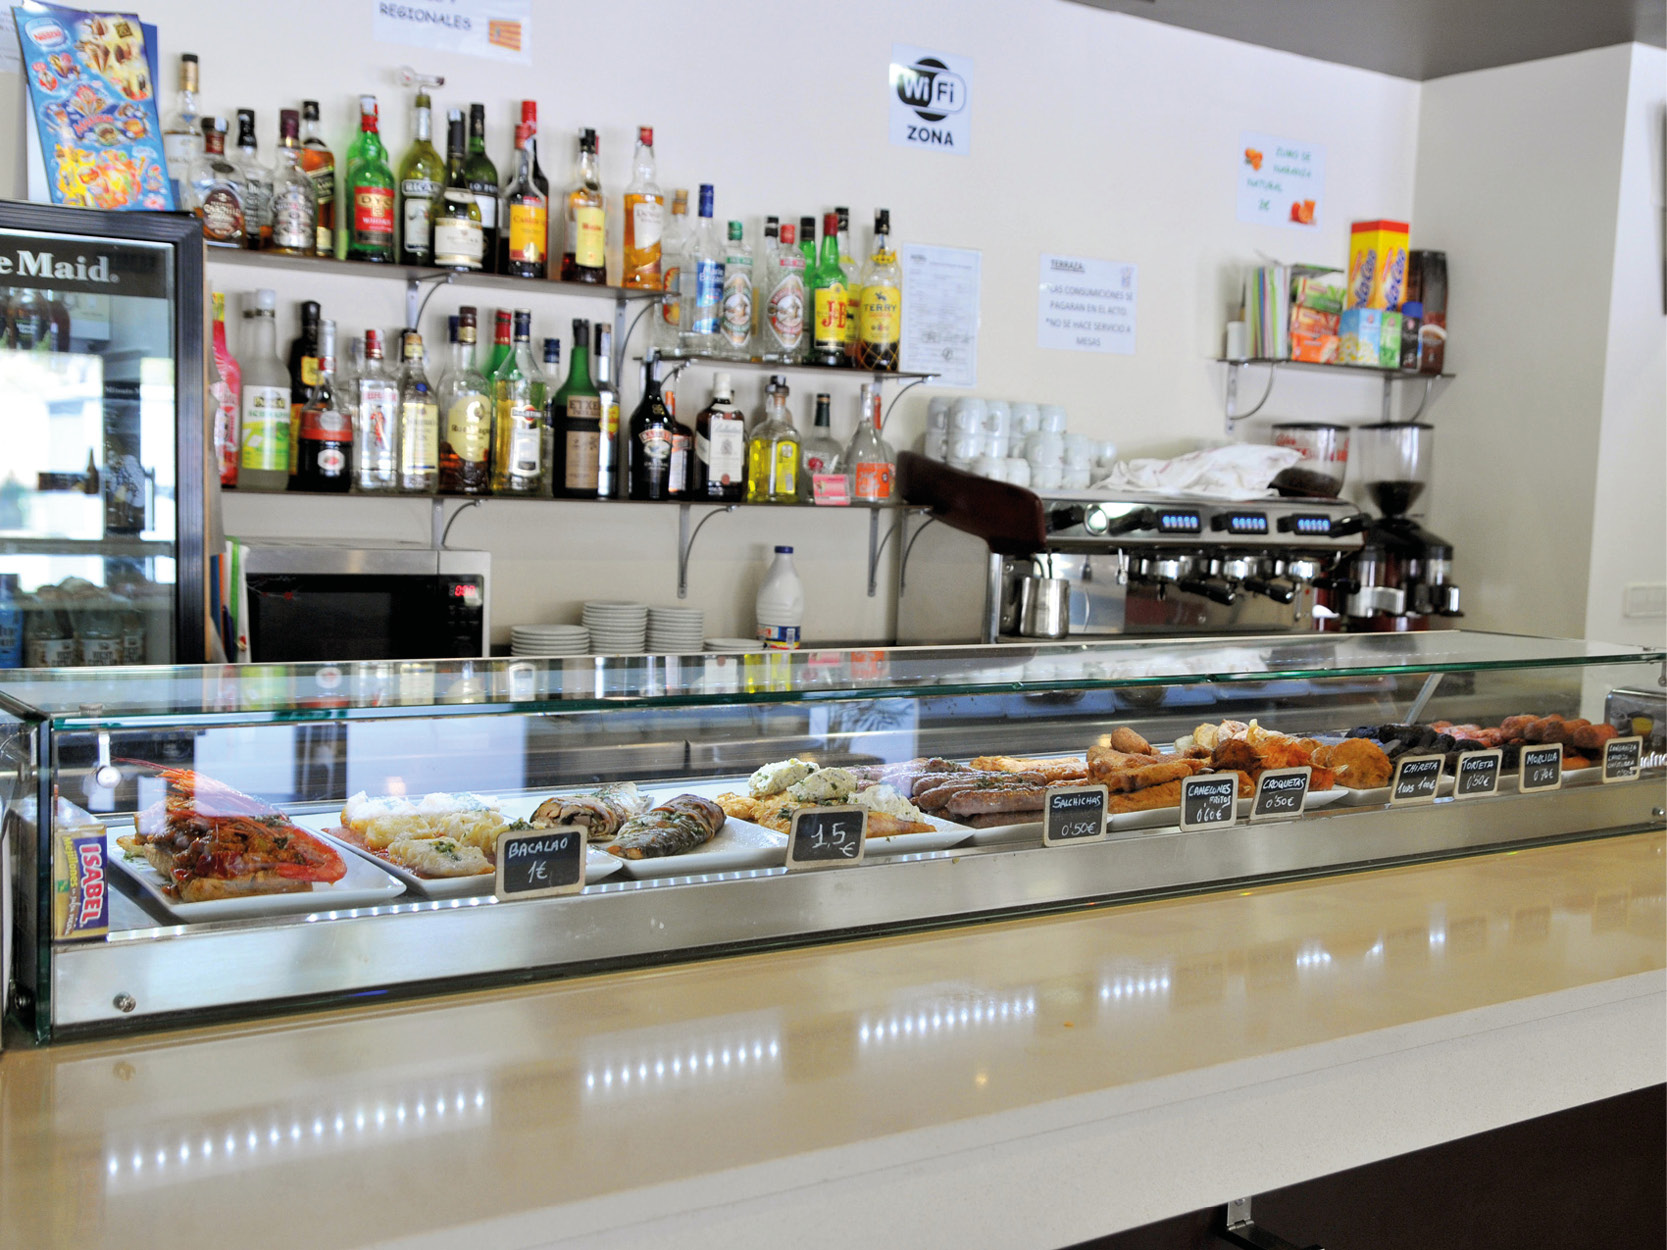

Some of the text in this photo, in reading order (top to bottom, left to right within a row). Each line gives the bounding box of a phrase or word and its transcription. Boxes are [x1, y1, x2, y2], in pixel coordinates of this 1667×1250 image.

[379, 2, 471, 30] REGIONALES
[907, 125, 954, 146] ZONA
[864, 303, 897, 312] TERRY
[1403, 762, 1438, 773] CHIRETA
[1462, 757, 1494, 771] TORTETA
[1188, 783, 1231, 796] CANELONES
[1263, 777, 1305, 791] CROQUETAS
[1052, 794, 1101, 809] SALCHICHAS
[508, 837, 568, 859] BACALAO
[63, 837, 78, 888] Mejillones
[528, 860, 547, 884] 1€
[80, 844, 104, 924] ISABEL
